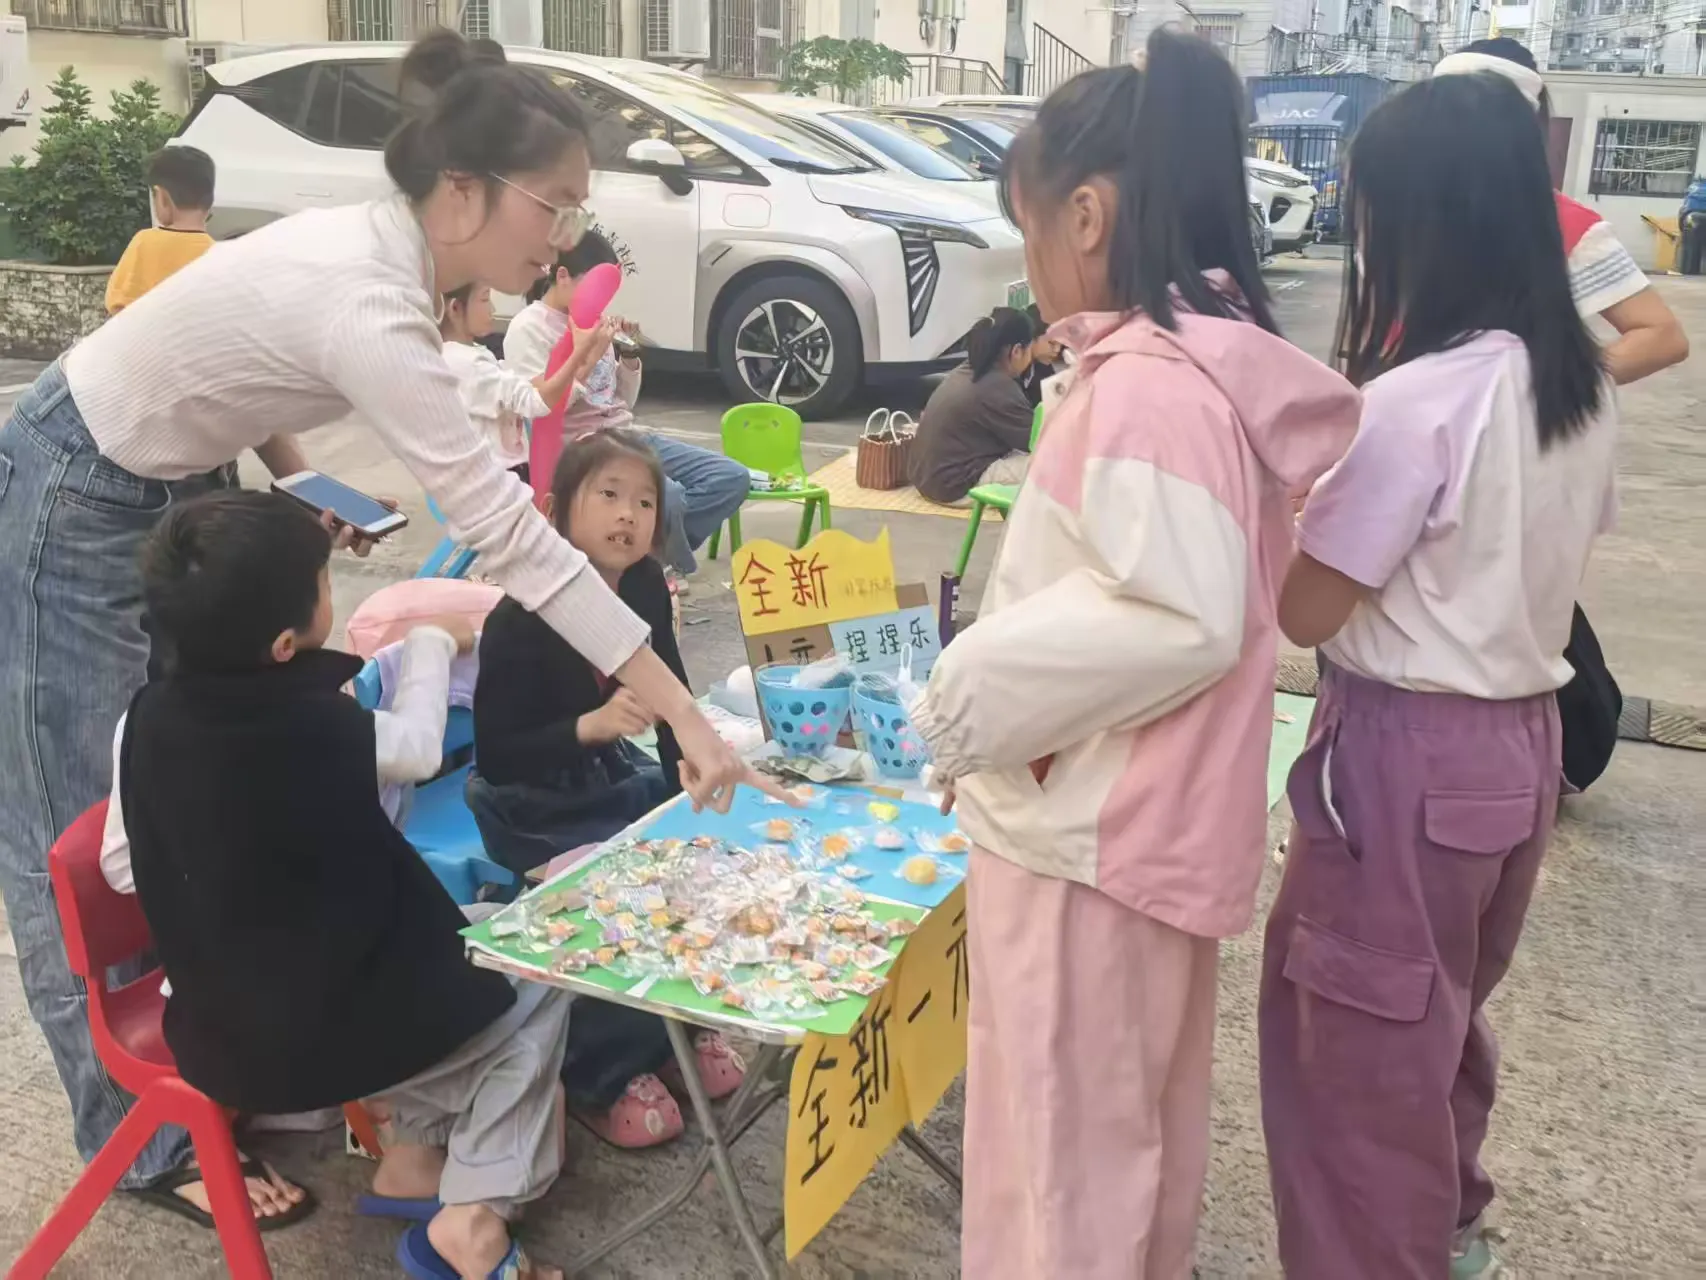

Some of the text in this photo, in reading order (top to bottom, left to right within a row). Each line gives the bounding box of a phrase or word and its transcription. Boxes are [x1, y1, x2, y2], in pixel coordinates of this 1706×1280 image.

[1275, 108, 1320, 119] JAC
[739, 552, 829, 616] 全新
[845, 616, 931, 663] 捏捏乐
